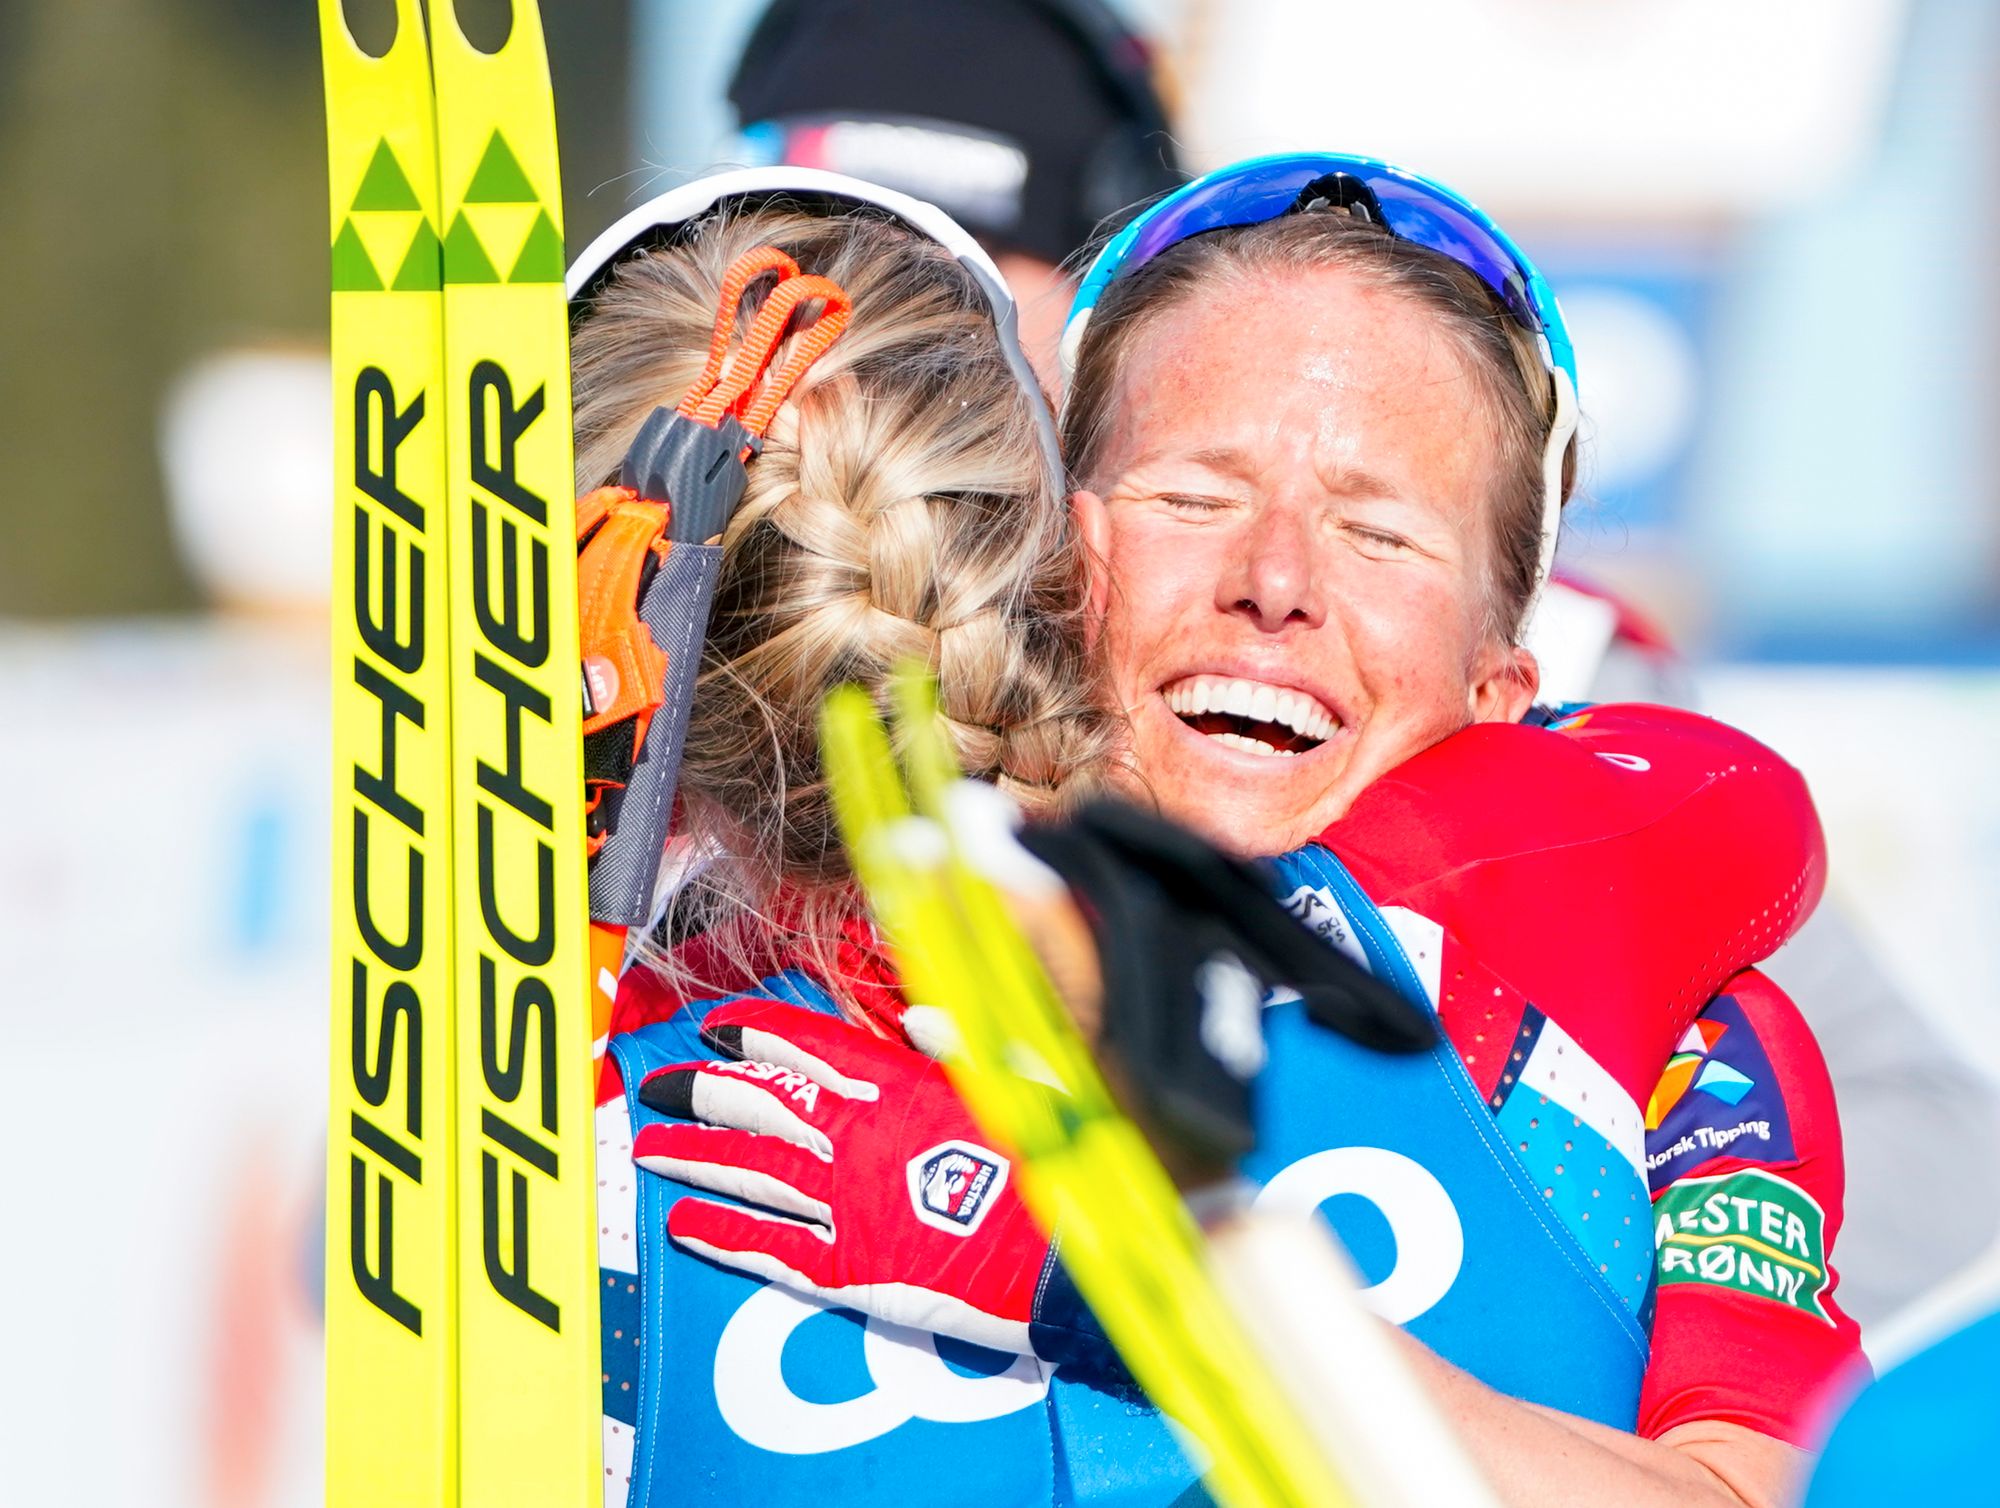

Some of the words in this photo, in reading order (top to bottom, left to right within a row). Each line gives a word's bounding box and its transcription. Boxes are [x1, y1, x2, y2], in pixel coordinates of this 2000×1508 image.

[351, 365, 426, 1338] FISCHER
[469, 359, 561, 1334] FISCHER
[956, 1164, 994, 1217] HESTRA
[1693, 1120, 1771, 1149] Tipping
